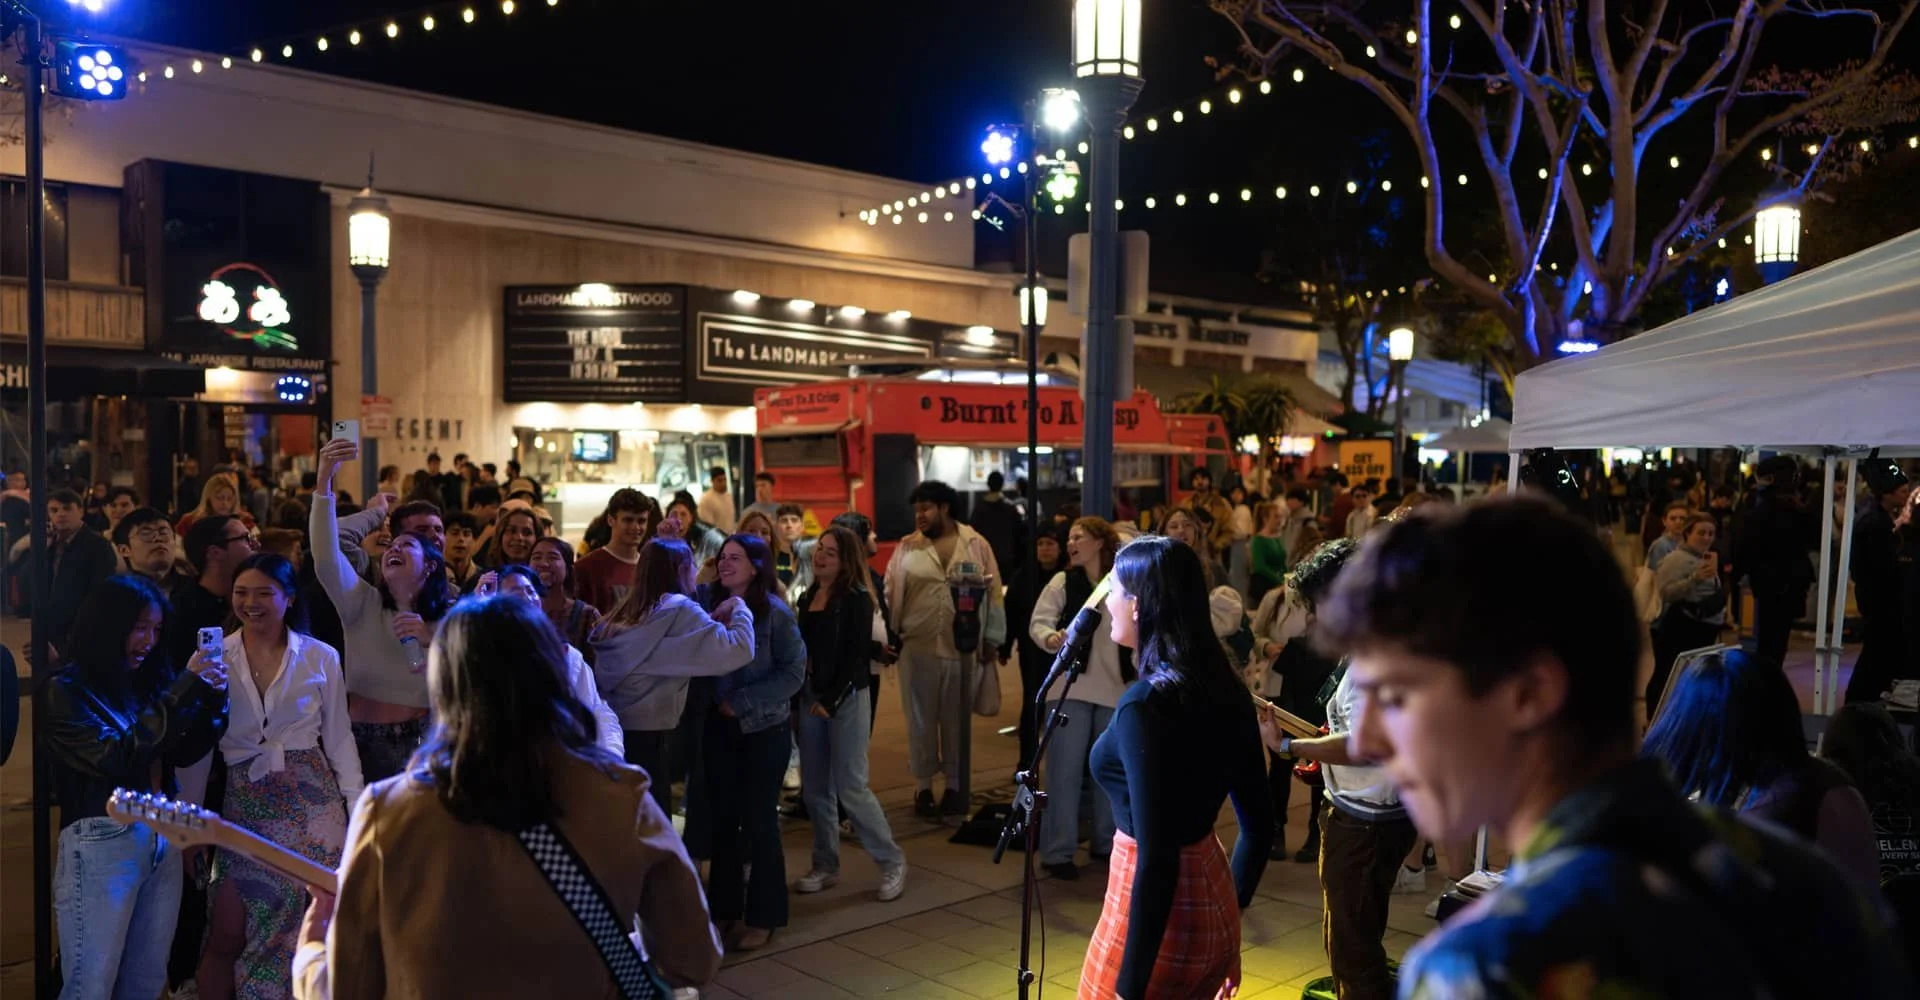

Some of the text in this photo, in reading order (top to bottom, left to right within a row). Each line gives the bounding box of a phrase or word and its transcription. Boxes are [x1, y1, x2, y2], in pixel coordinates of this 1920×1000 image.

[518, 293, 672, 306] LANDMA STWOOD
[712, 337, 745, 359] The
[252, 355, 325, 370] RESTAURANT
[940, 397, 1016, 424] Burnt
[1058, 401, 1078, 425] A
[395, 418, 464, 440] EGENT
